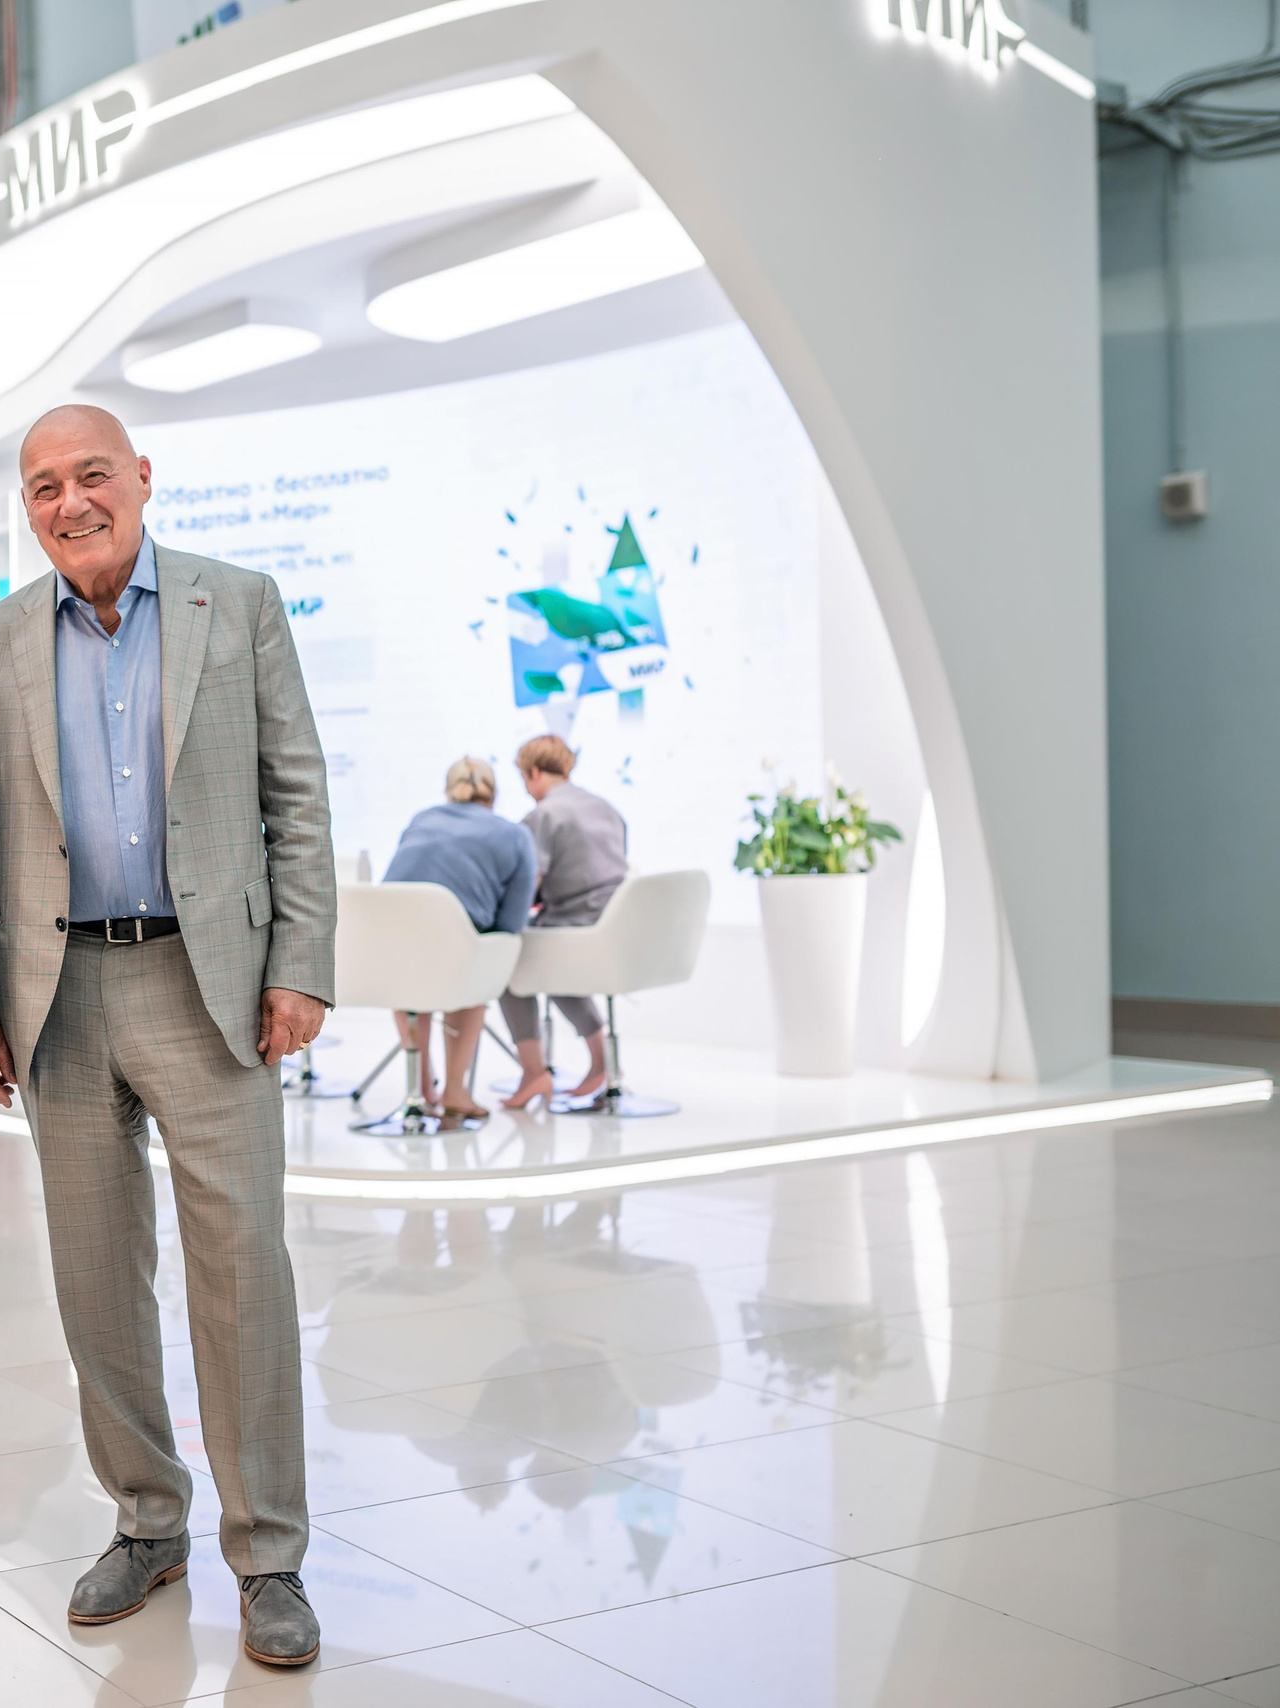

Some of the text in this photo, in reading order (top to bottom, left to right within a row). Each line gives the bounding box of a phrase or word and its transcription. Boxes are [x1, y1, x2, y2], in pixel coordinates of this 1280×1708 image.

[7, 87, 138, 219] МИР
[157, 482, 252, 507] Обратно
[274, 468, 388, 492] бесплатно
[175, 507, 252, 531] картой
